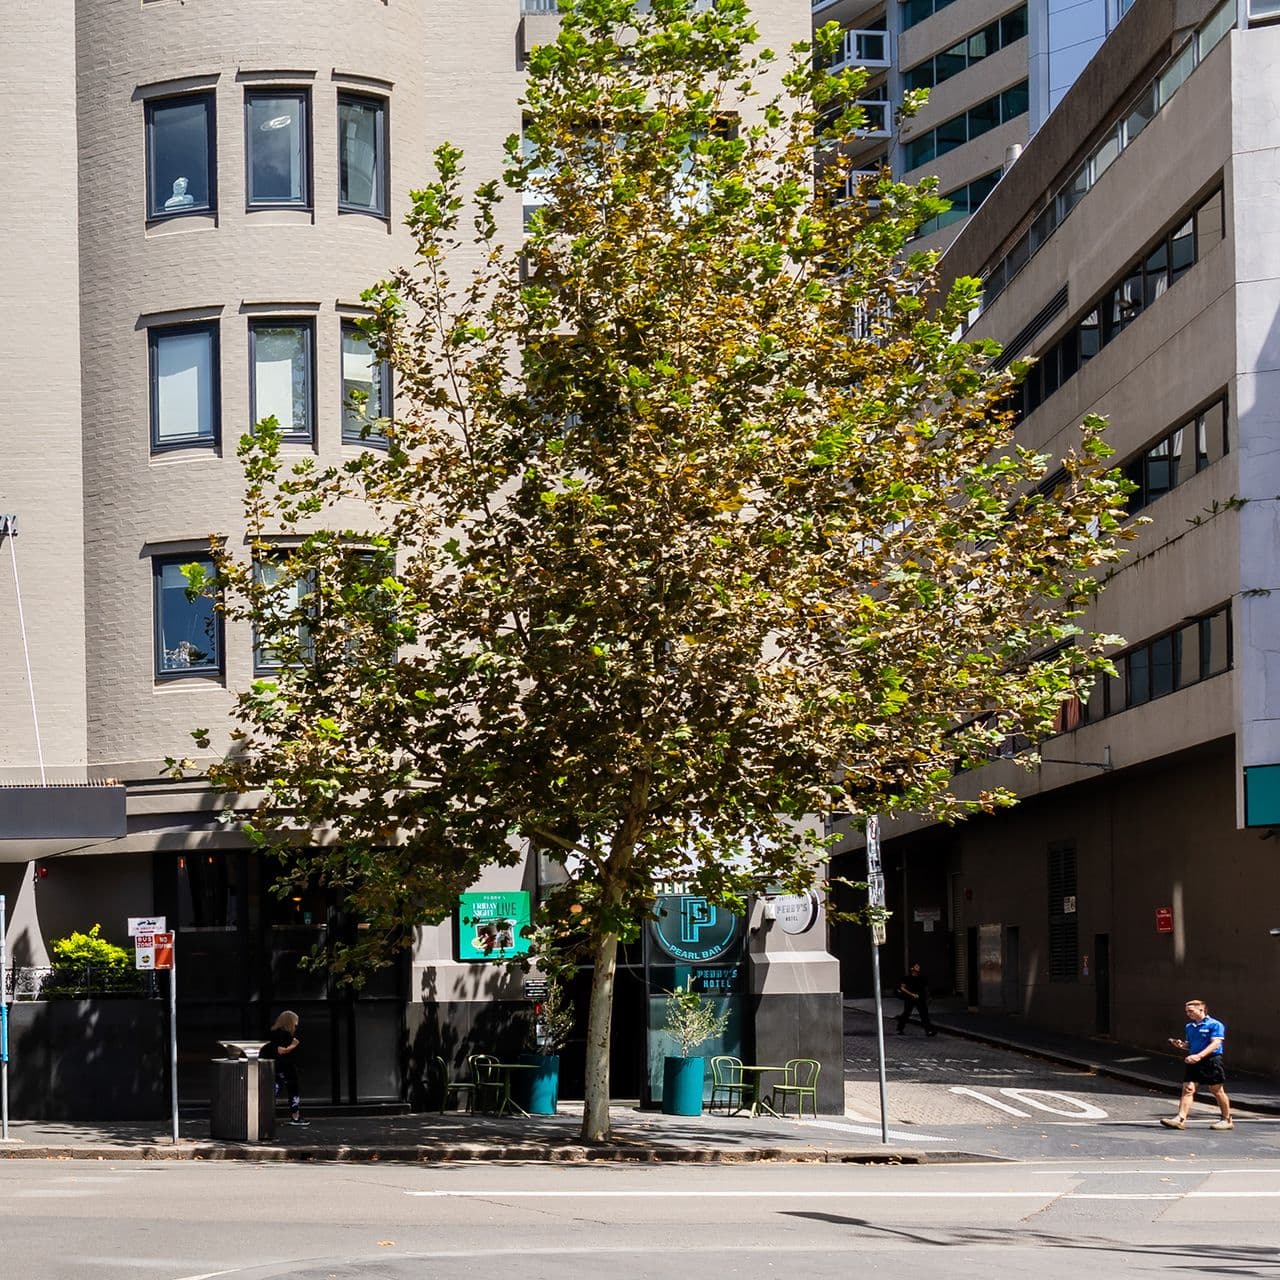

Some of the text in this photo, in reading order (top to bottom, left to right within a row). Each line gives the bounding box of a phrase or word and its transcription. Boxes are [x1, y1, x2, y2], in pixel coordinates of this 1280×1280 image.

[497, 902, 517, 916] LIVE
[669, 945, 721, 959] PEARL BAR
[703, 979, 731, 988] HOTEL
[948, 1086, 1109, 1119] 10
